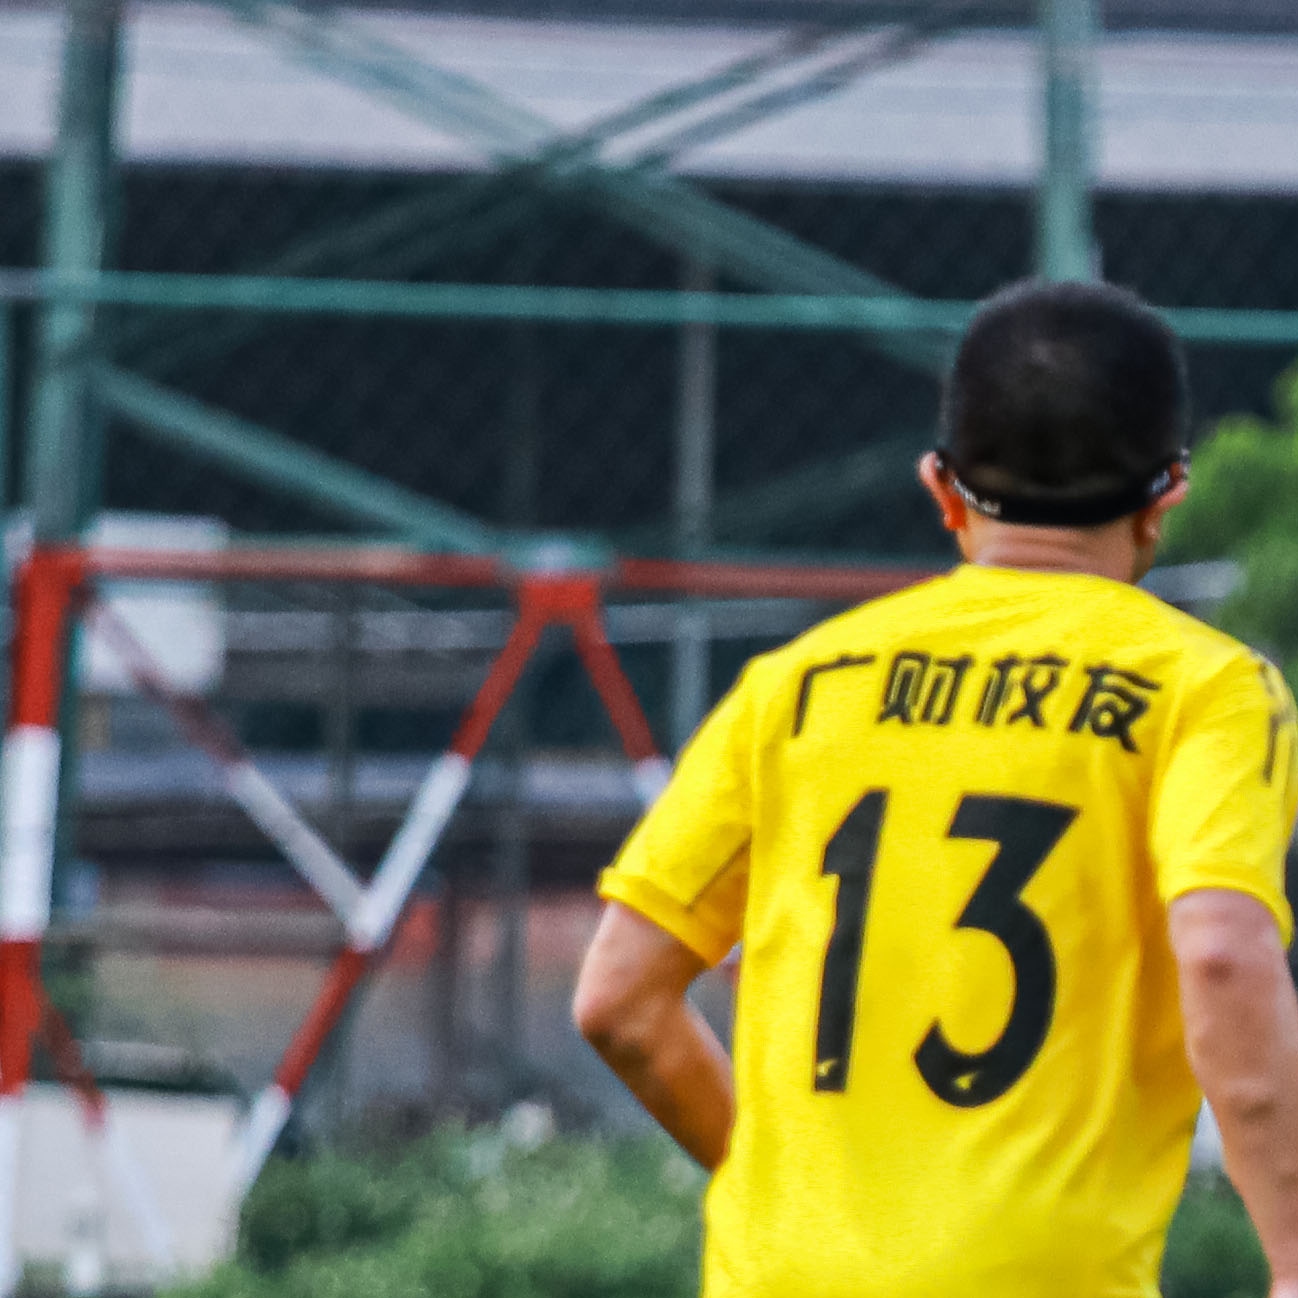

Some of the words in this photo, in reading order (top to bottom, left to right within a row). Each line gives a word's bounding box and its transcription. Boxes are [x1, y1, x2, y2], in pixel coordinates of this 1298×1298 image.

[791, 652, 1161, 753] 广财校友
[811, 786, 1082, 1109] 13
